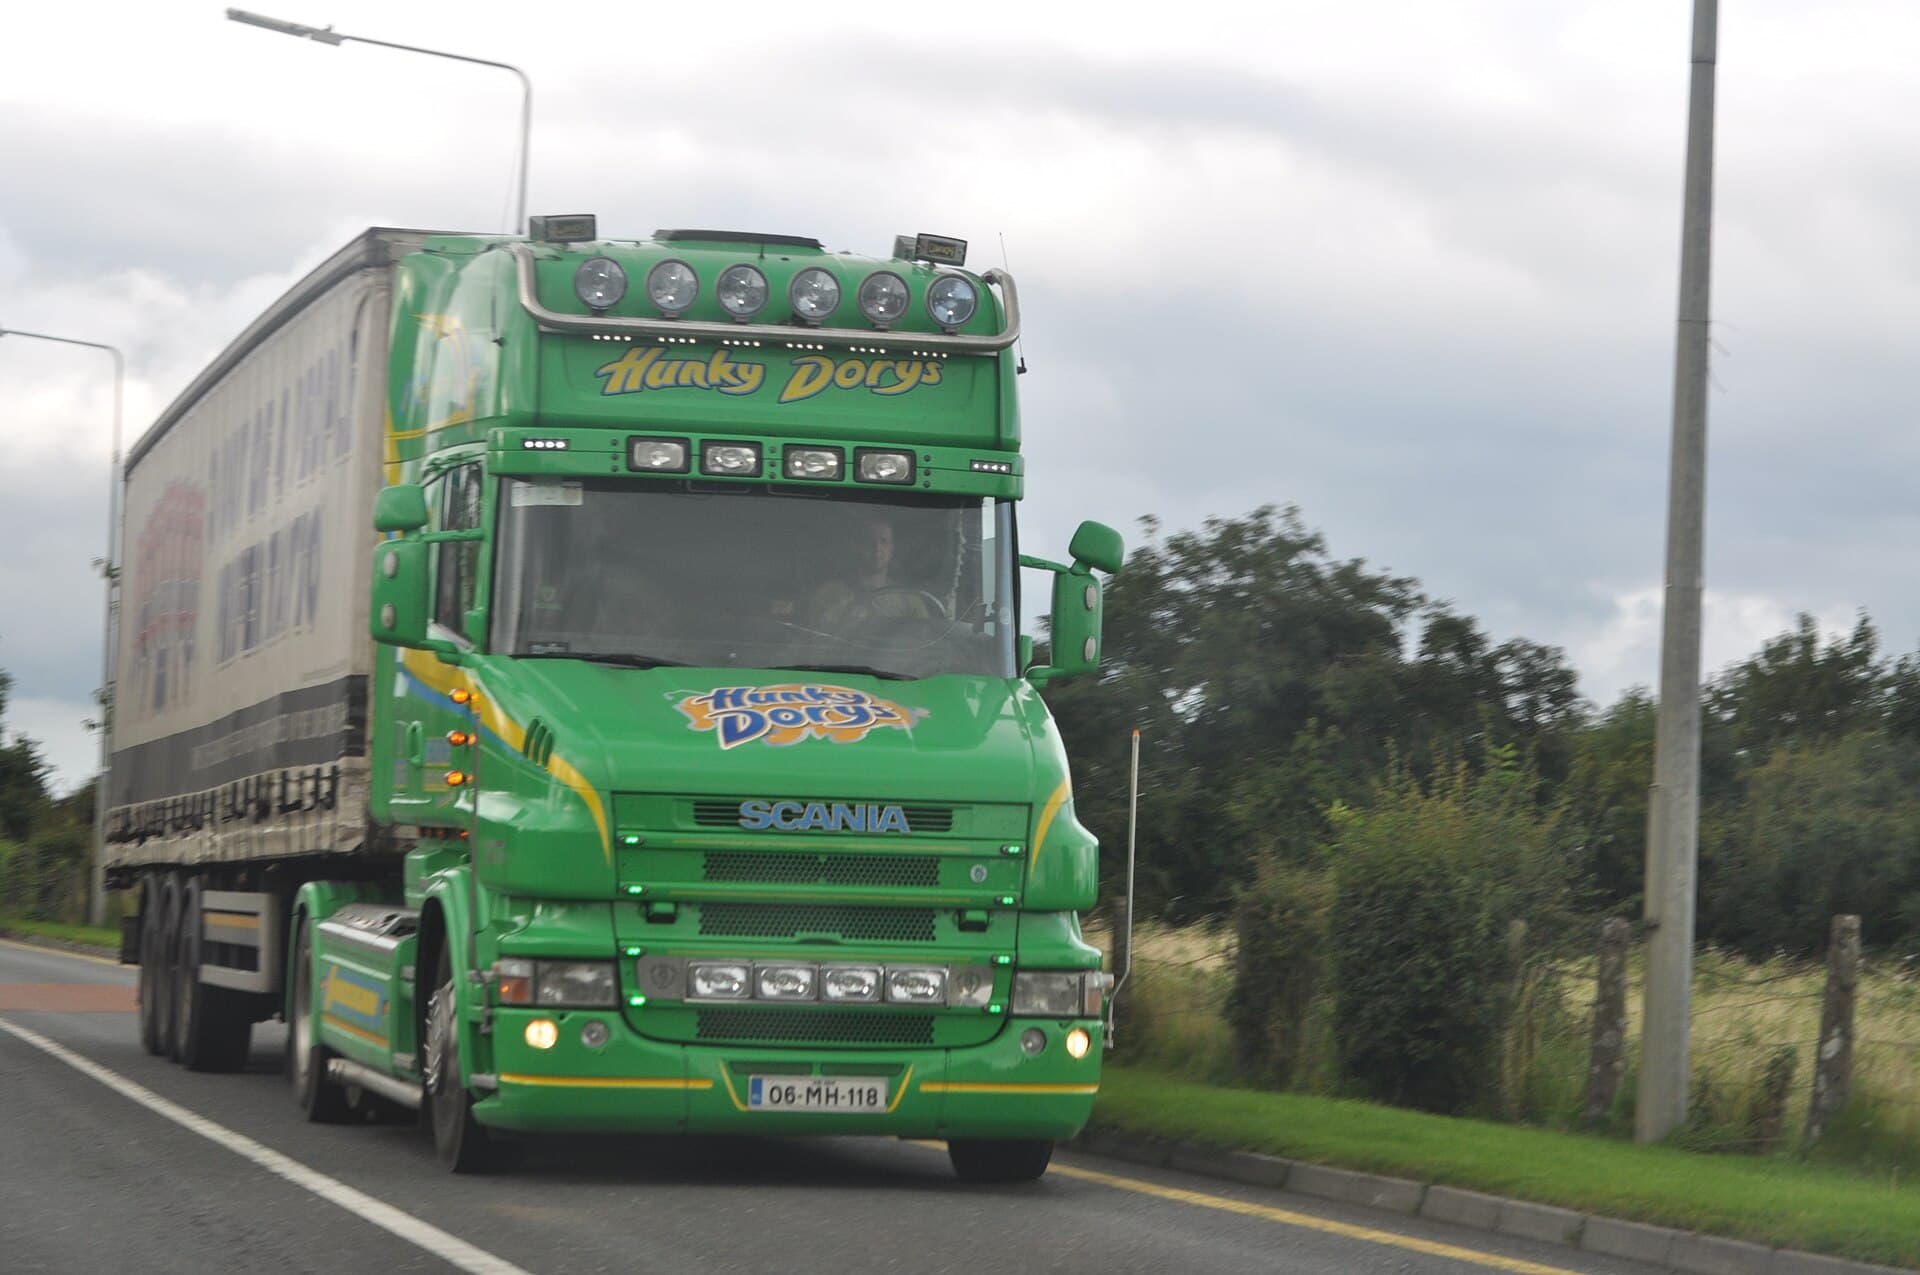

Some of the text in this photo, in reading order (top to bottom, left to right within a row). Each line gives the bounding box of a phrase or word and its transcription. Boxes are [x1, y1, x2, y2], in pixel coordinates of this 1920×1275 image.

[595, 345, 944, 403] Hunky Dorys
[692, 685, 874, 711] Hunky
[704, 704, 902, 750] Dorys
[739, 800, 911, 833] SCANIA
[769, 1085, 878, 1107] 06-MH-118
